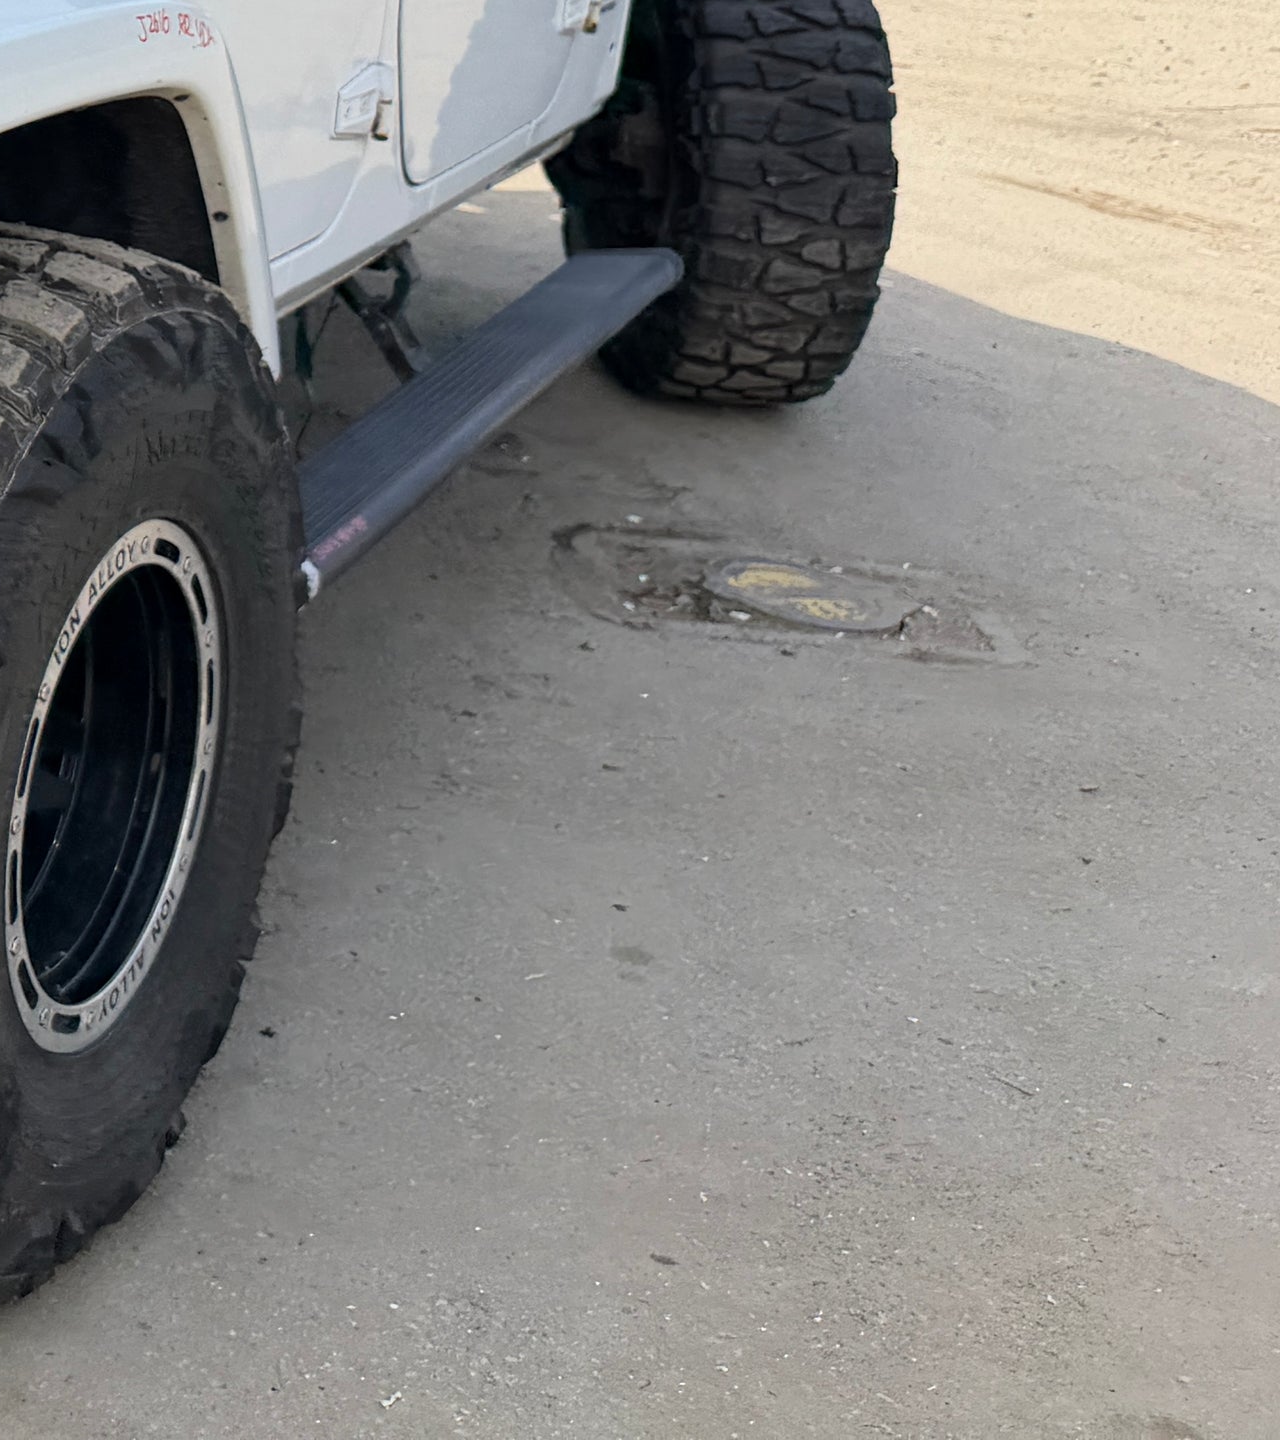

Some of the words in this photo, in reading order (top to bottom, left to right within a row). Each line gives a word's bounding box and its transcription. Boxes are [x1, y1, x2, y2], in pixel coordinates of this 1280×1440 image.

[52, 606, 82, 665] ION
[87, 539, 138, 607] ALLOY
[150, 888, 176, 943] ION
[98, 947, 146, 1023] ALLOY
